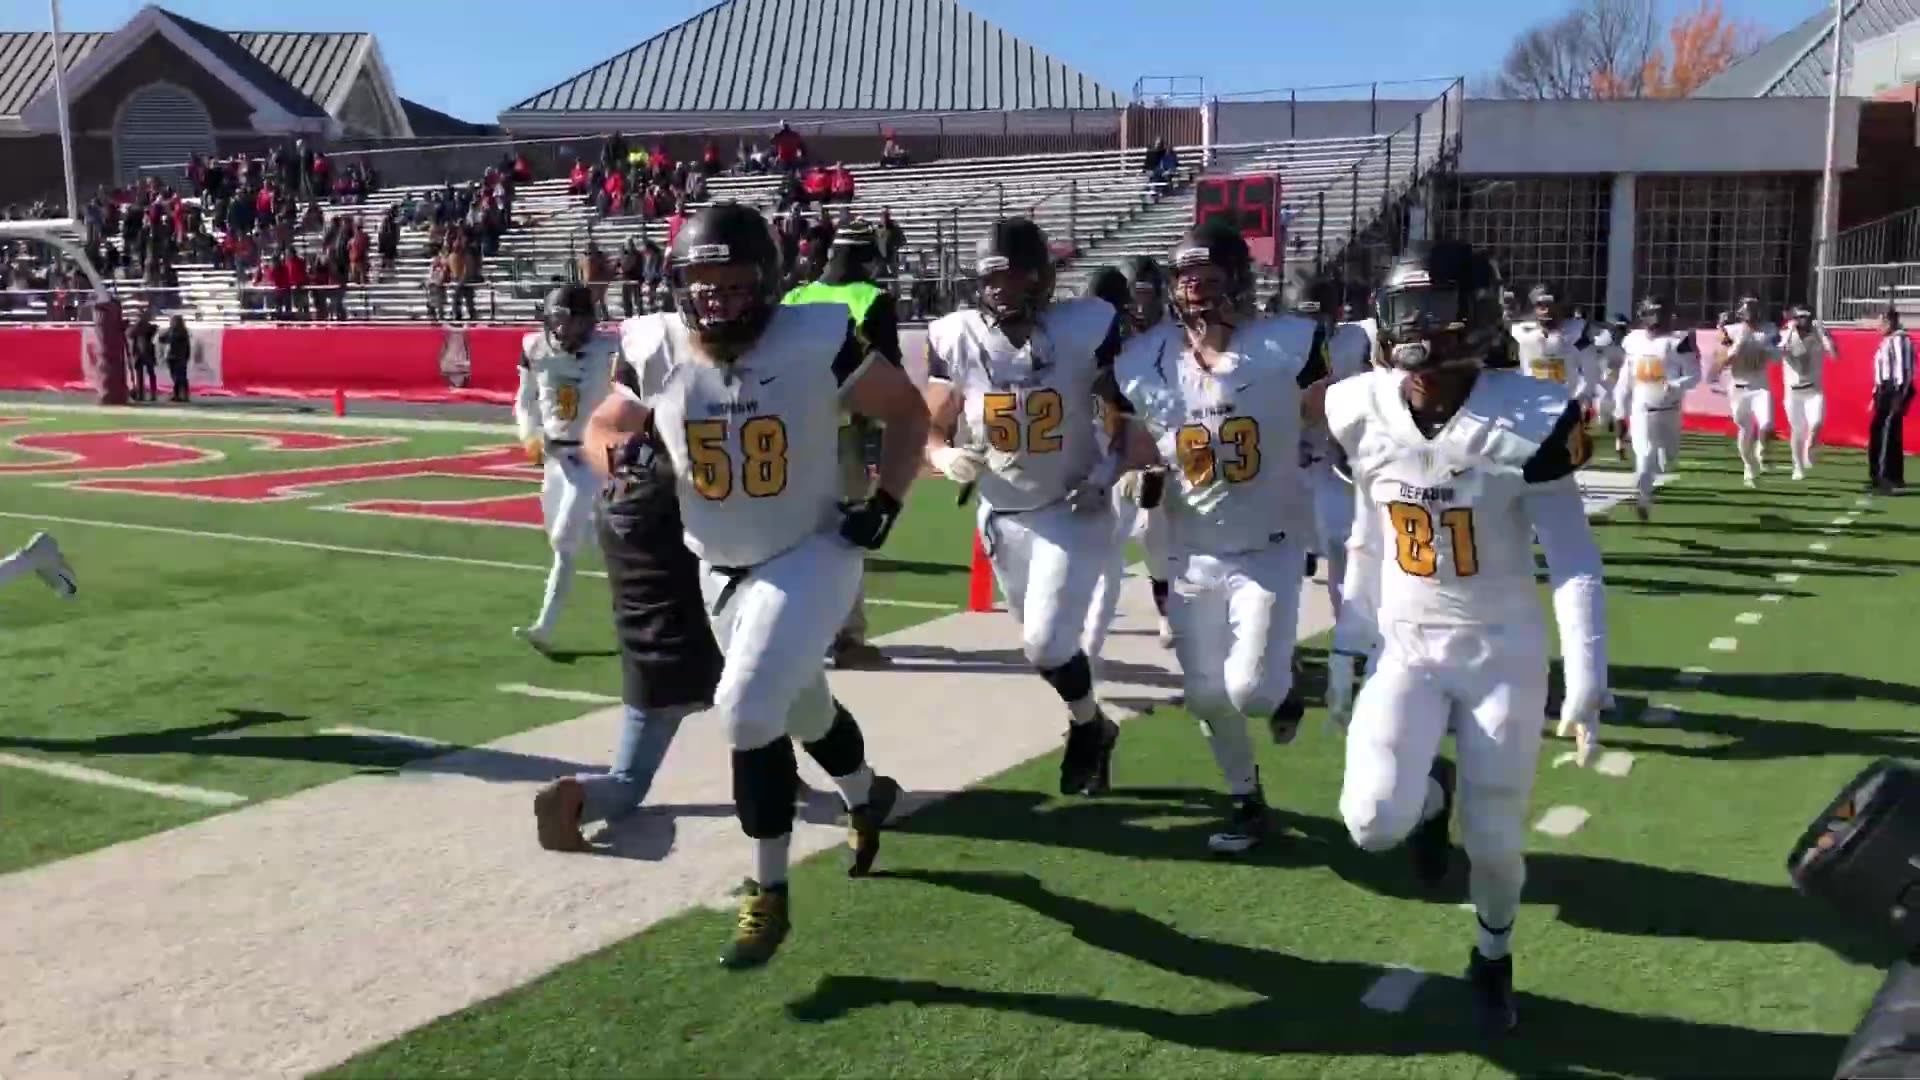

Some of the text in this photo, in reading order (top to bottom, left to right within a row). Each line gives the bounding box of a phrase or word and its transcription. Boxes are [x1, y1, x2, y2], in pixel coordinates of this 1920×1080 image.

[1199, 176, 1268, 237] 25
[983, 388, 1064, 454] 52
[1176, 415, 1261, 488] 63
[685, 414, 788, 502] 58
[1386, 500, 1479, 577] 81
